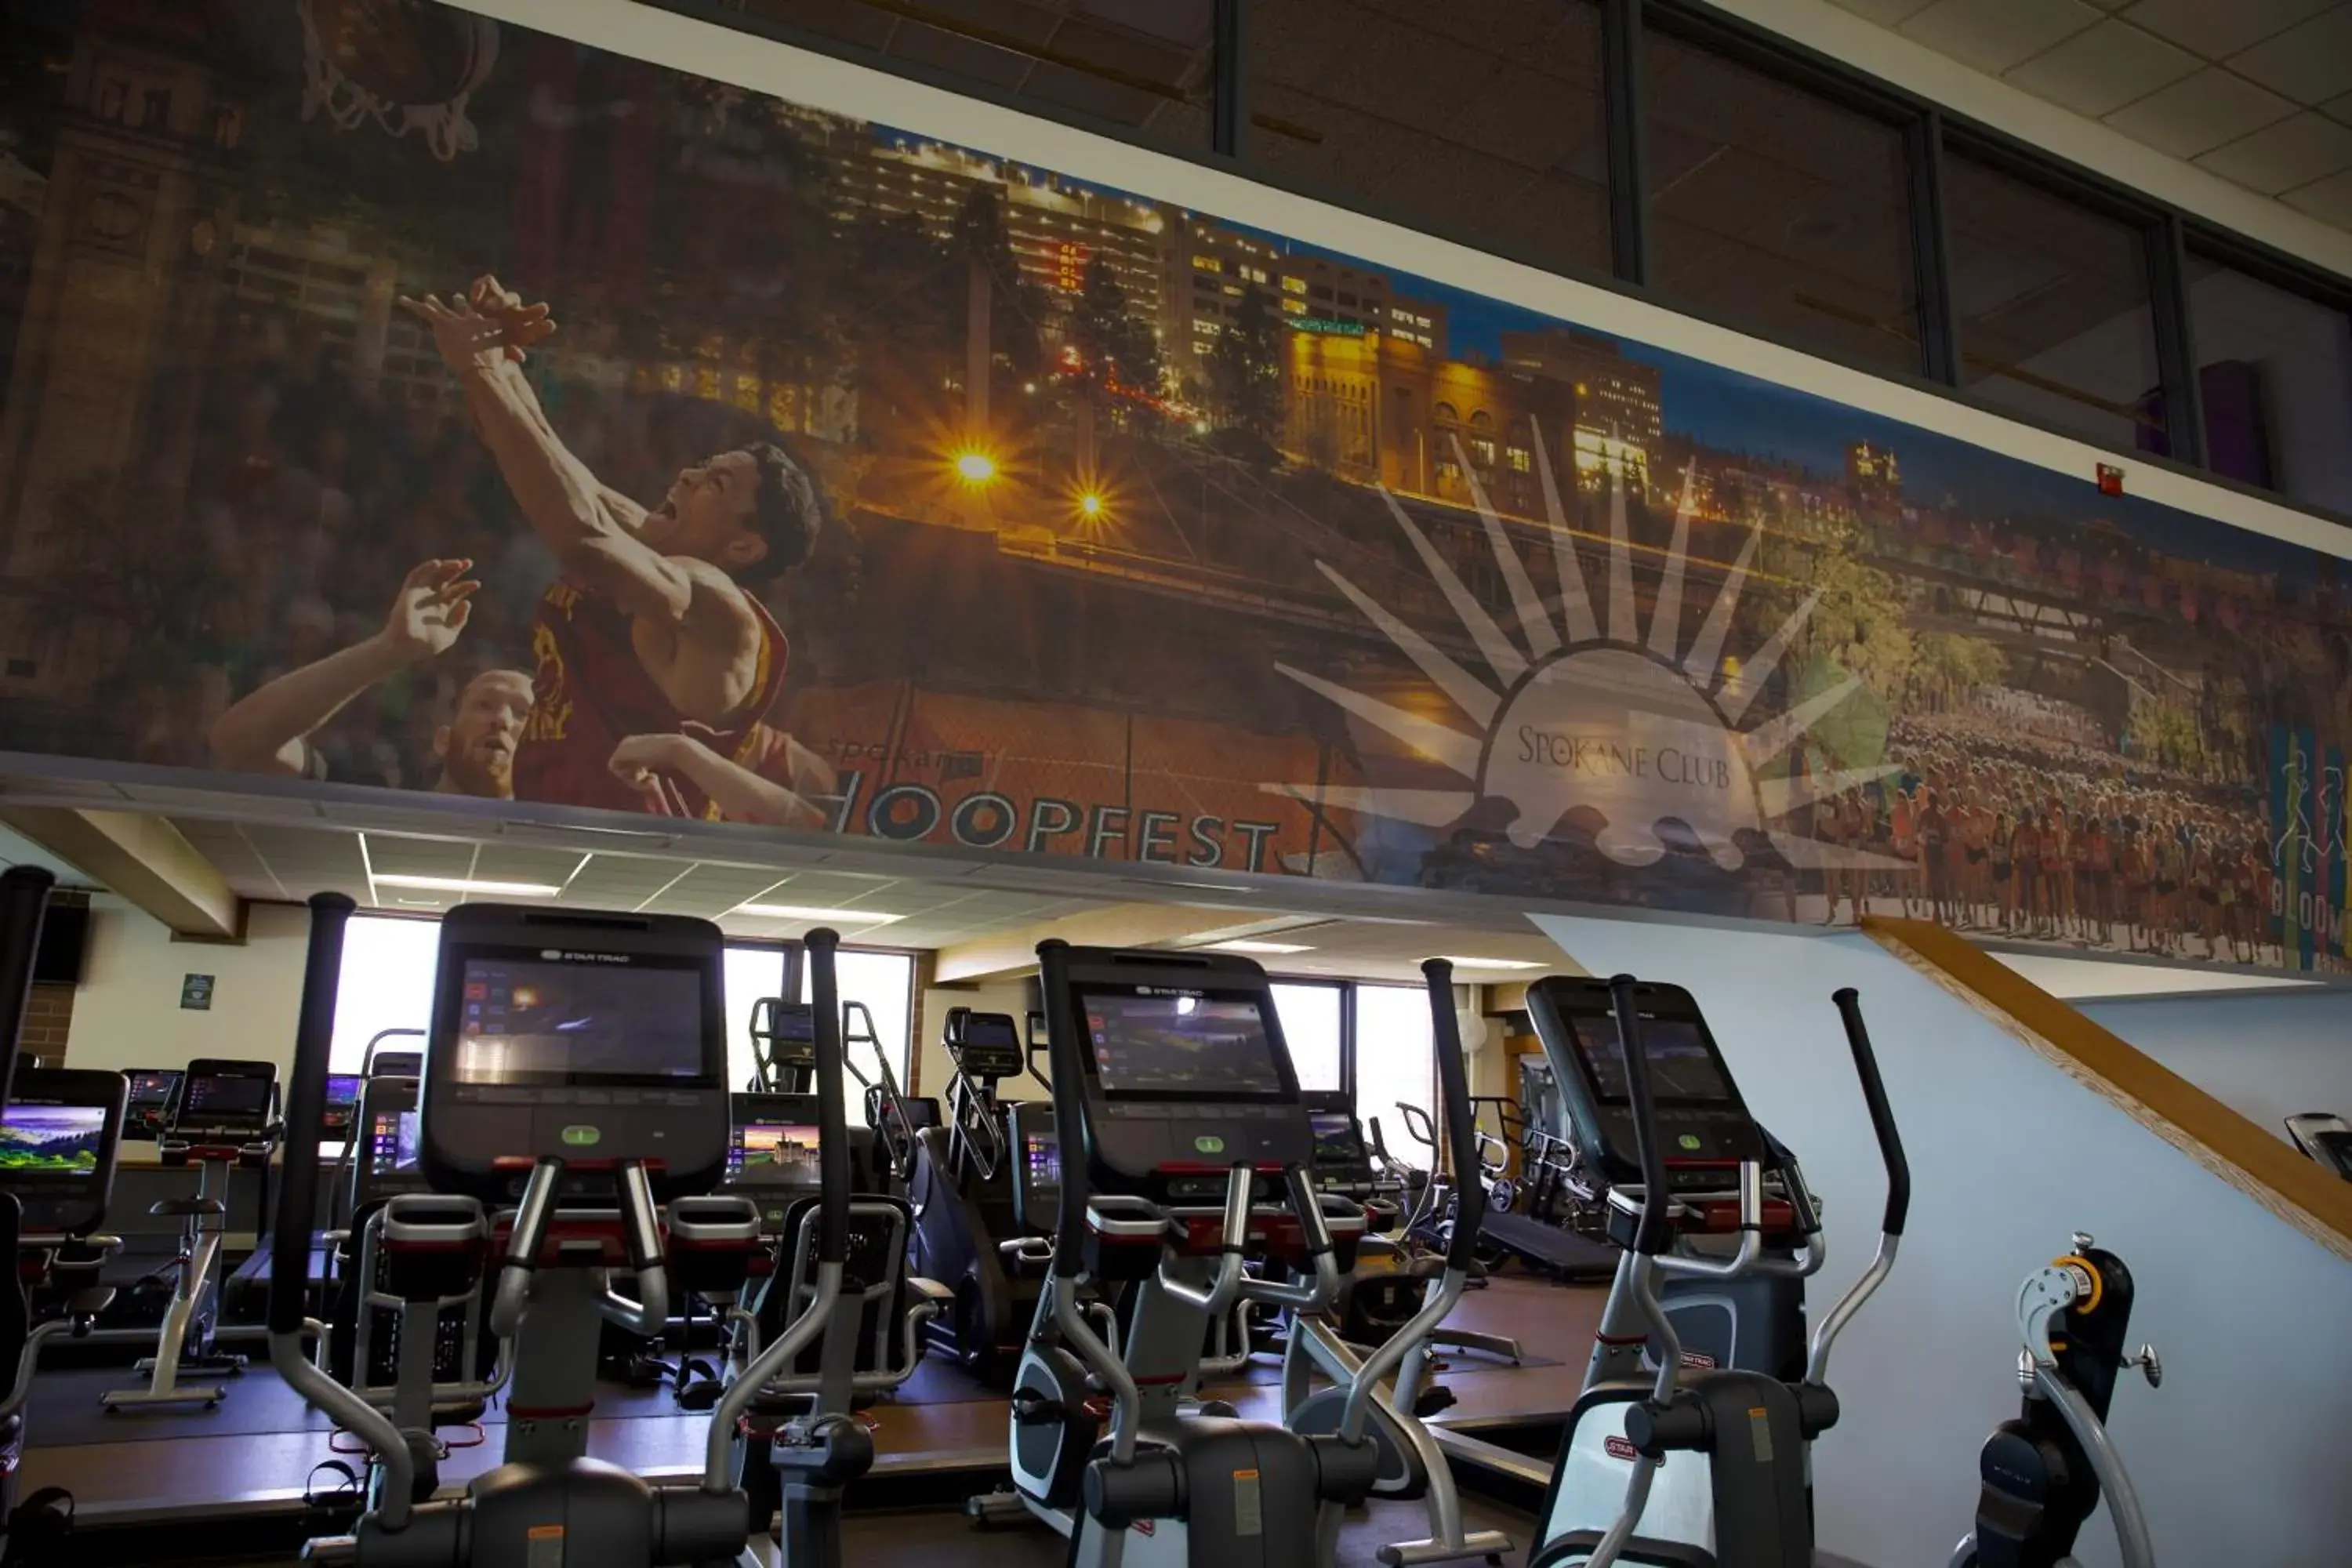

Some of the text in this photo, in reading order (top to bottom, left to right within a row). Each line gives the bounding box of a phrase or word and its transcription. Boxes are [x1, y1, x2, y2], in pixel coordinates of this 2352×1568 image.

[1518, 725, 1730, 789] SPOKANE CLUB
[597, 954, 630, 963] TRAC
